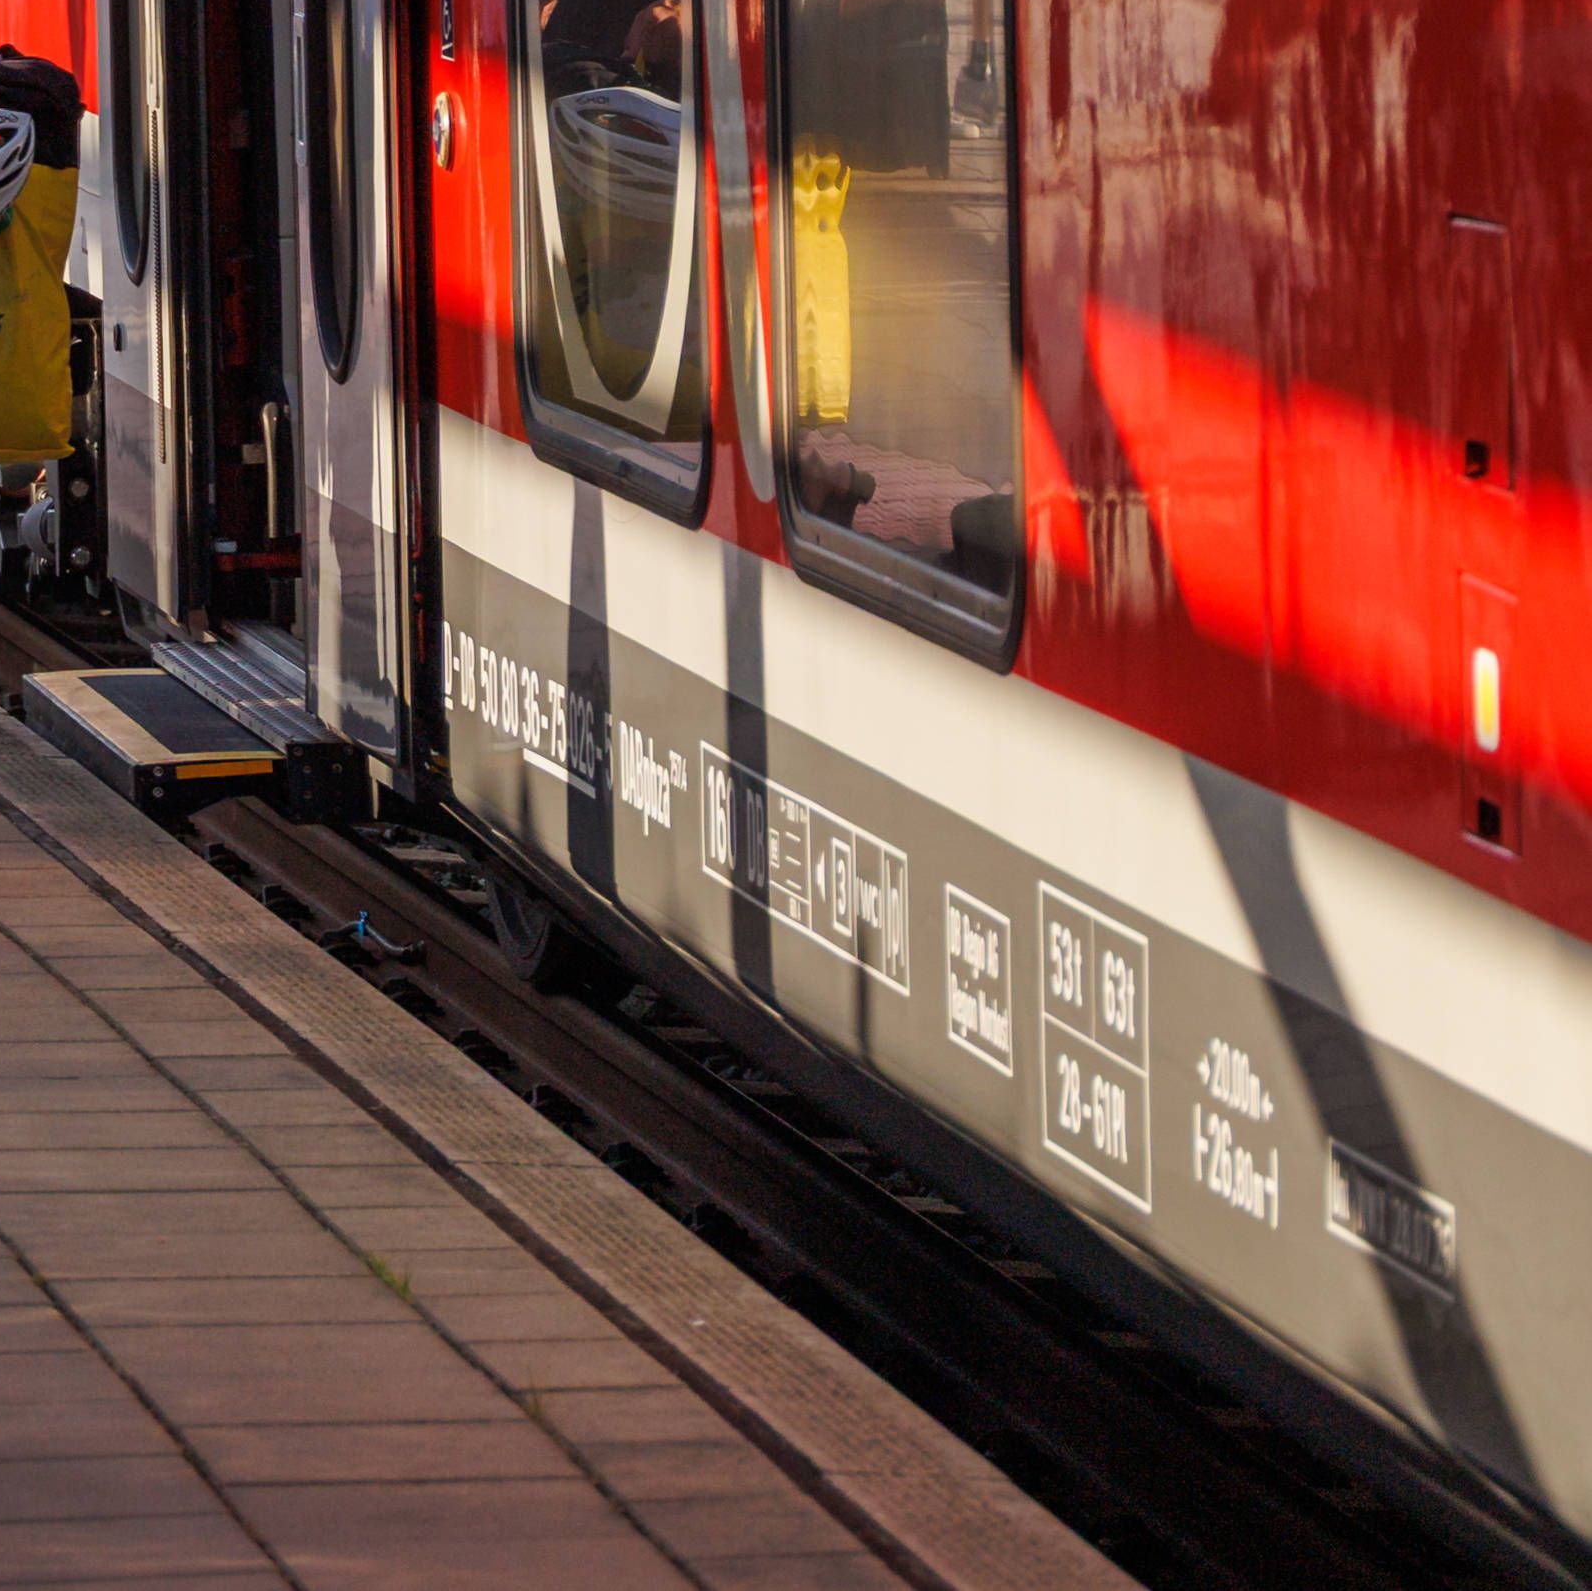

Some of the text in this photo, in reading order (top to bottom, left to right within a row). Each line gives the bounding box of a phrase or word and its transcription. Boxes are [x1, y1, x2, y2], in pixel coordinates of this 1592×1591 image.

[480, 645, 498, 727] 50
[501, 656, 519, 737] 80
[520, 666, 567, 763] 36-75
[707, 765, 766, 888] 160 DB
[837, 859, 847, 915] 3
